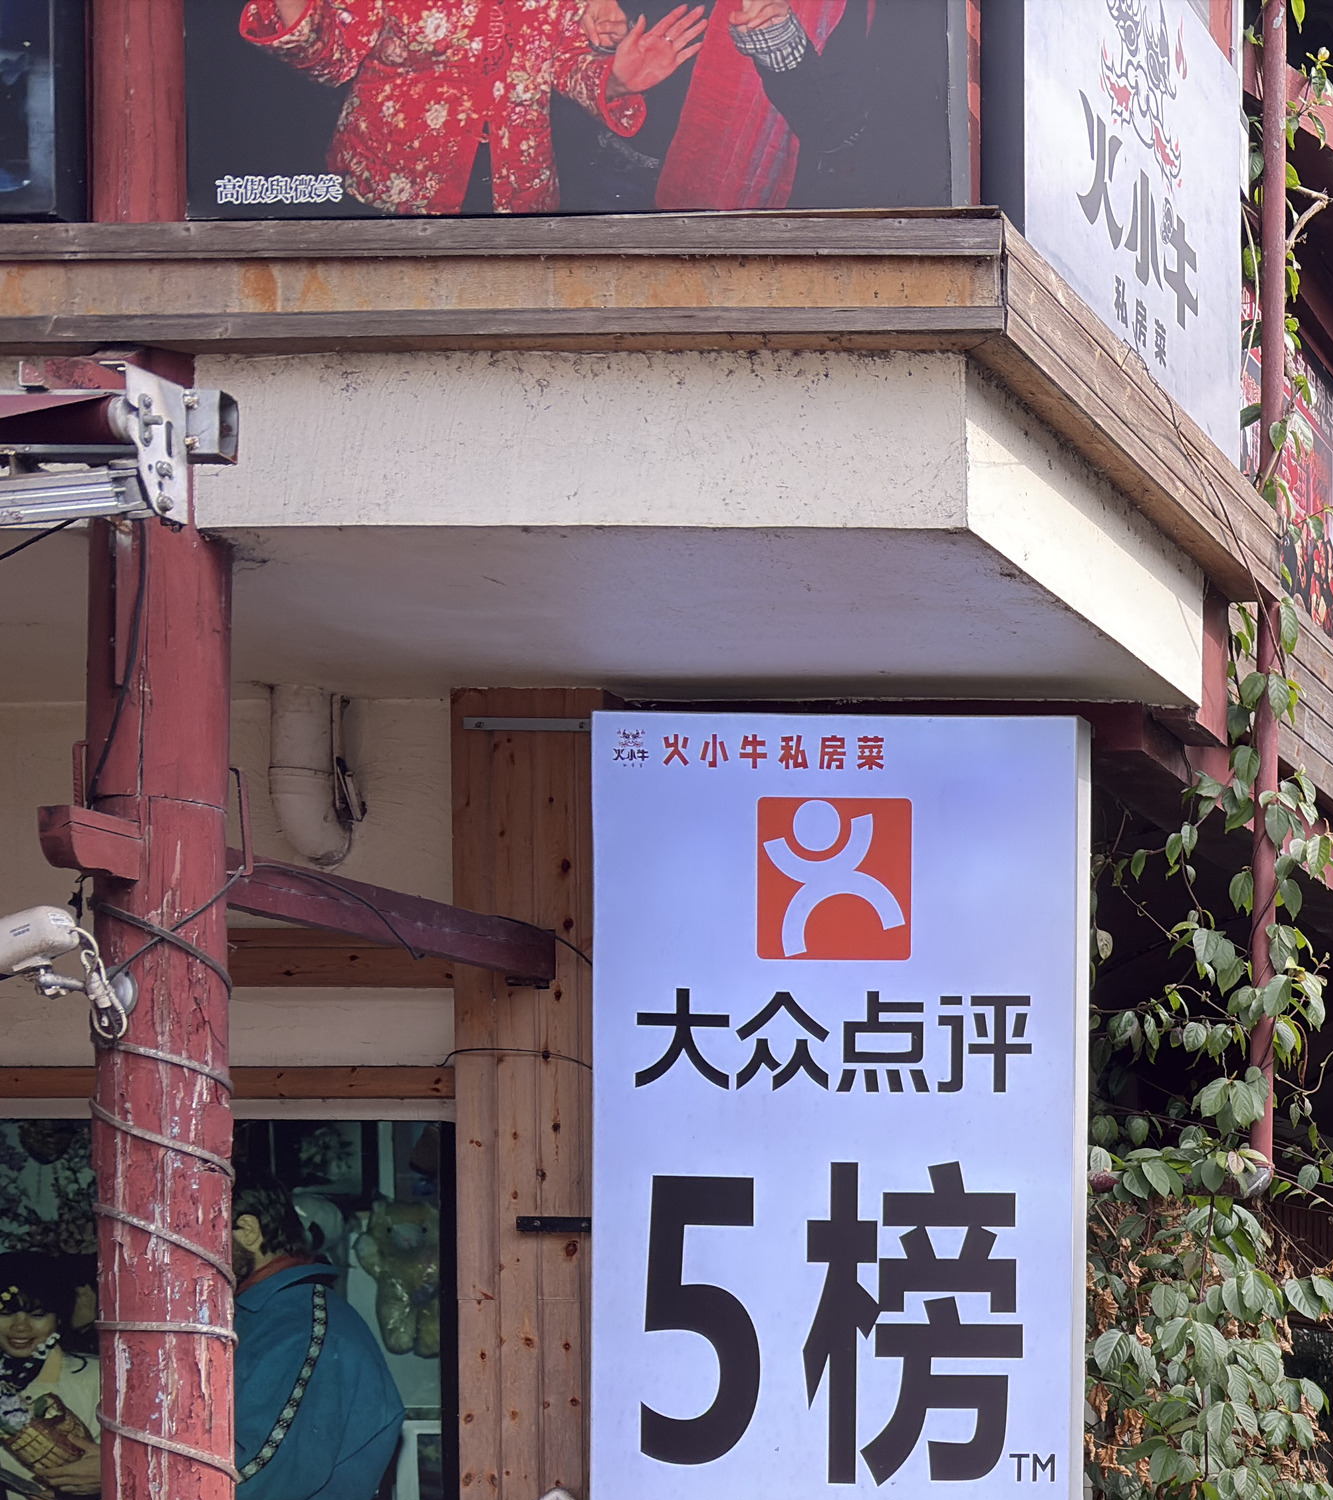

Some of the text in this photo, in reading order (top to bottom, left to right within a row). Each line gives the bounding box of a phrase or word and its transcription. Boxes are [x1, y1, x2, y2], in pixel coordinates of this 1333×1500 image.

[215, 174, 343, 204] 高傲與微笑
[1077, 89, 1199, 329] 火小牛
[1114, 275, 1167, 370] 私房菜
[662, 733, 885, 770] 火小牛私房菜
[634, 988, 1033, 1093] 大众点评
[640, 1160, 1024, 1487] 5榜
